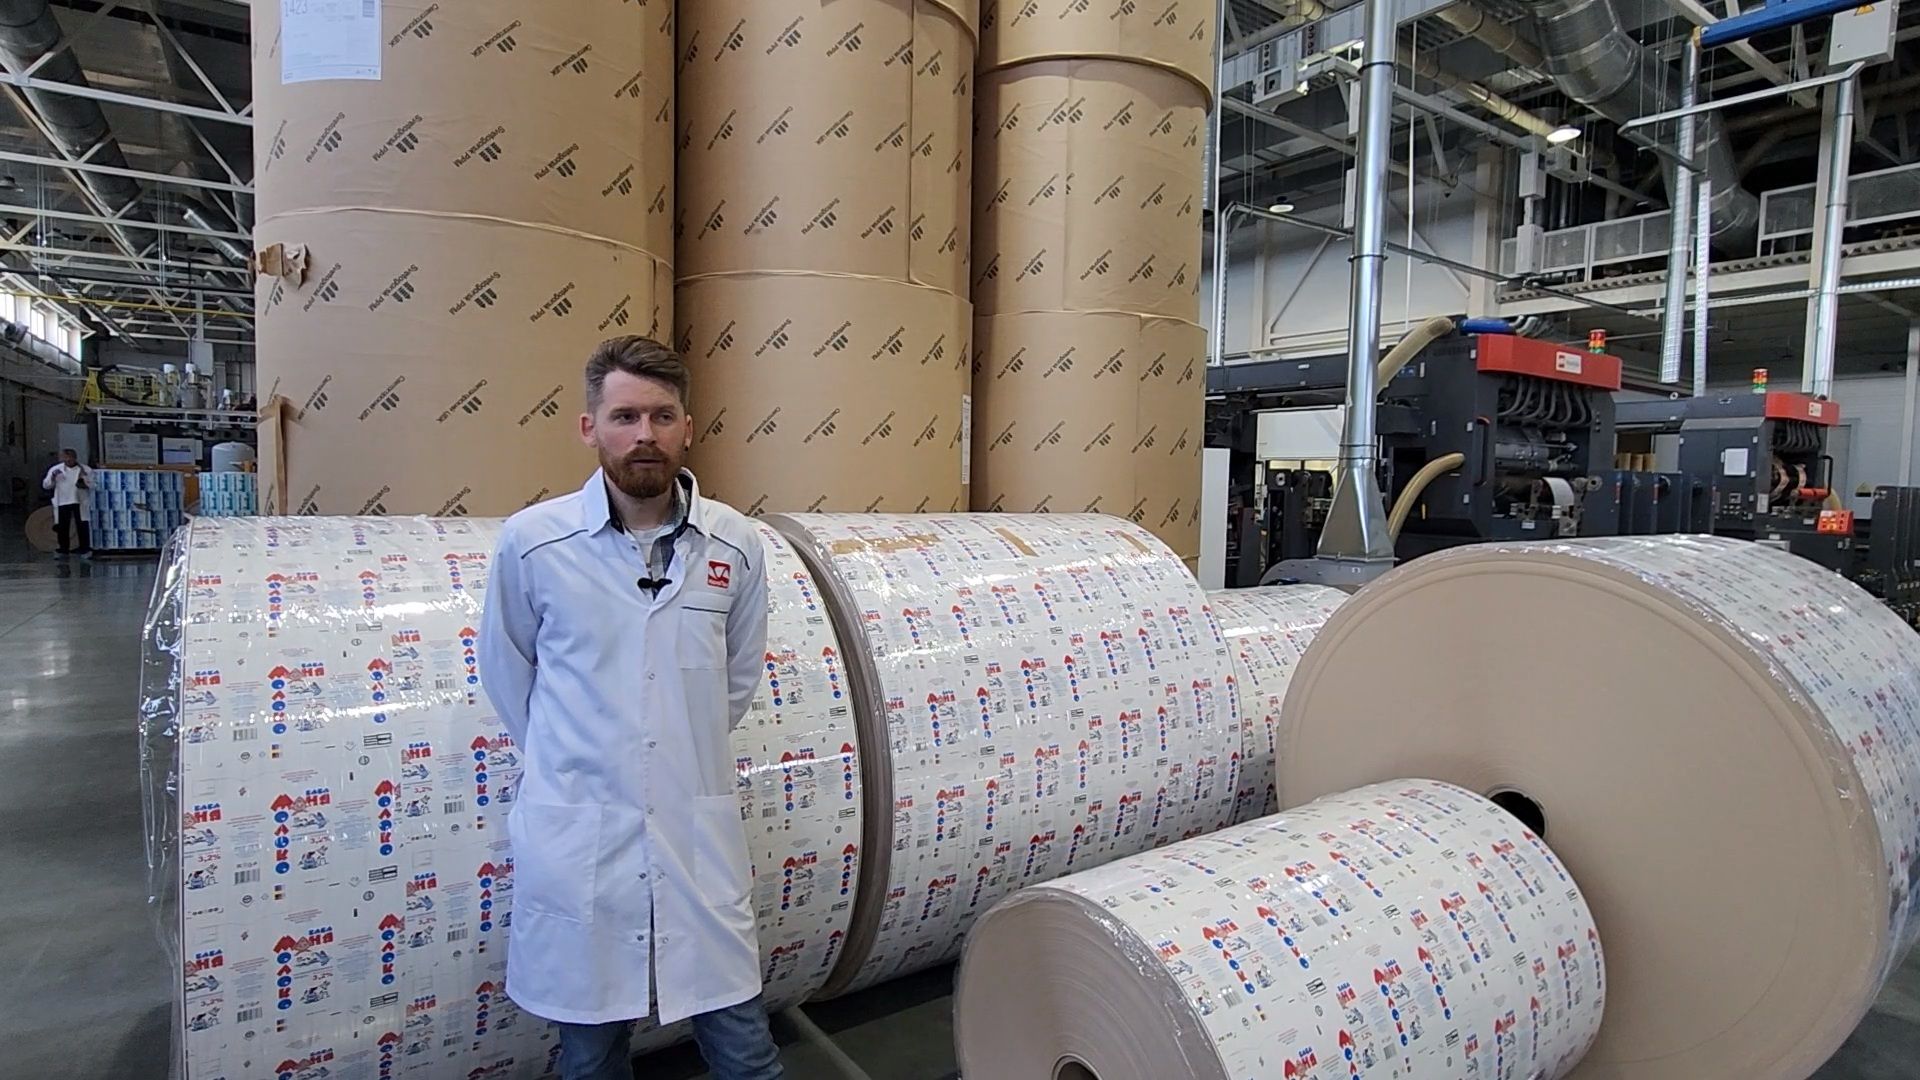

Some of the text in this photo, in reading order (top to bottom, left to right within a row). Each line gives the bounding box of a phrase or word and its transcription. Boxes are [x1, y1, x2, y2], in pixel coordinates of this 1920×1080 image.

[305, 112, 345, 162] Svetogorsk PPM
[372, 114, 422, 160] Svetogorsk PPM
[453, 125, 505, 167] Svetogorsk PPM
[534, 143, 578, 179] Svetogorsk PPM
[303, 263, 341, 312] Svetogorsk PPM
[368, 264, 418, 311] Svetogorsk PPM
[448, 271, 500, 314] Svetogorsk PPM
[530, 282, 574, 322] Svetogorsk PPM
